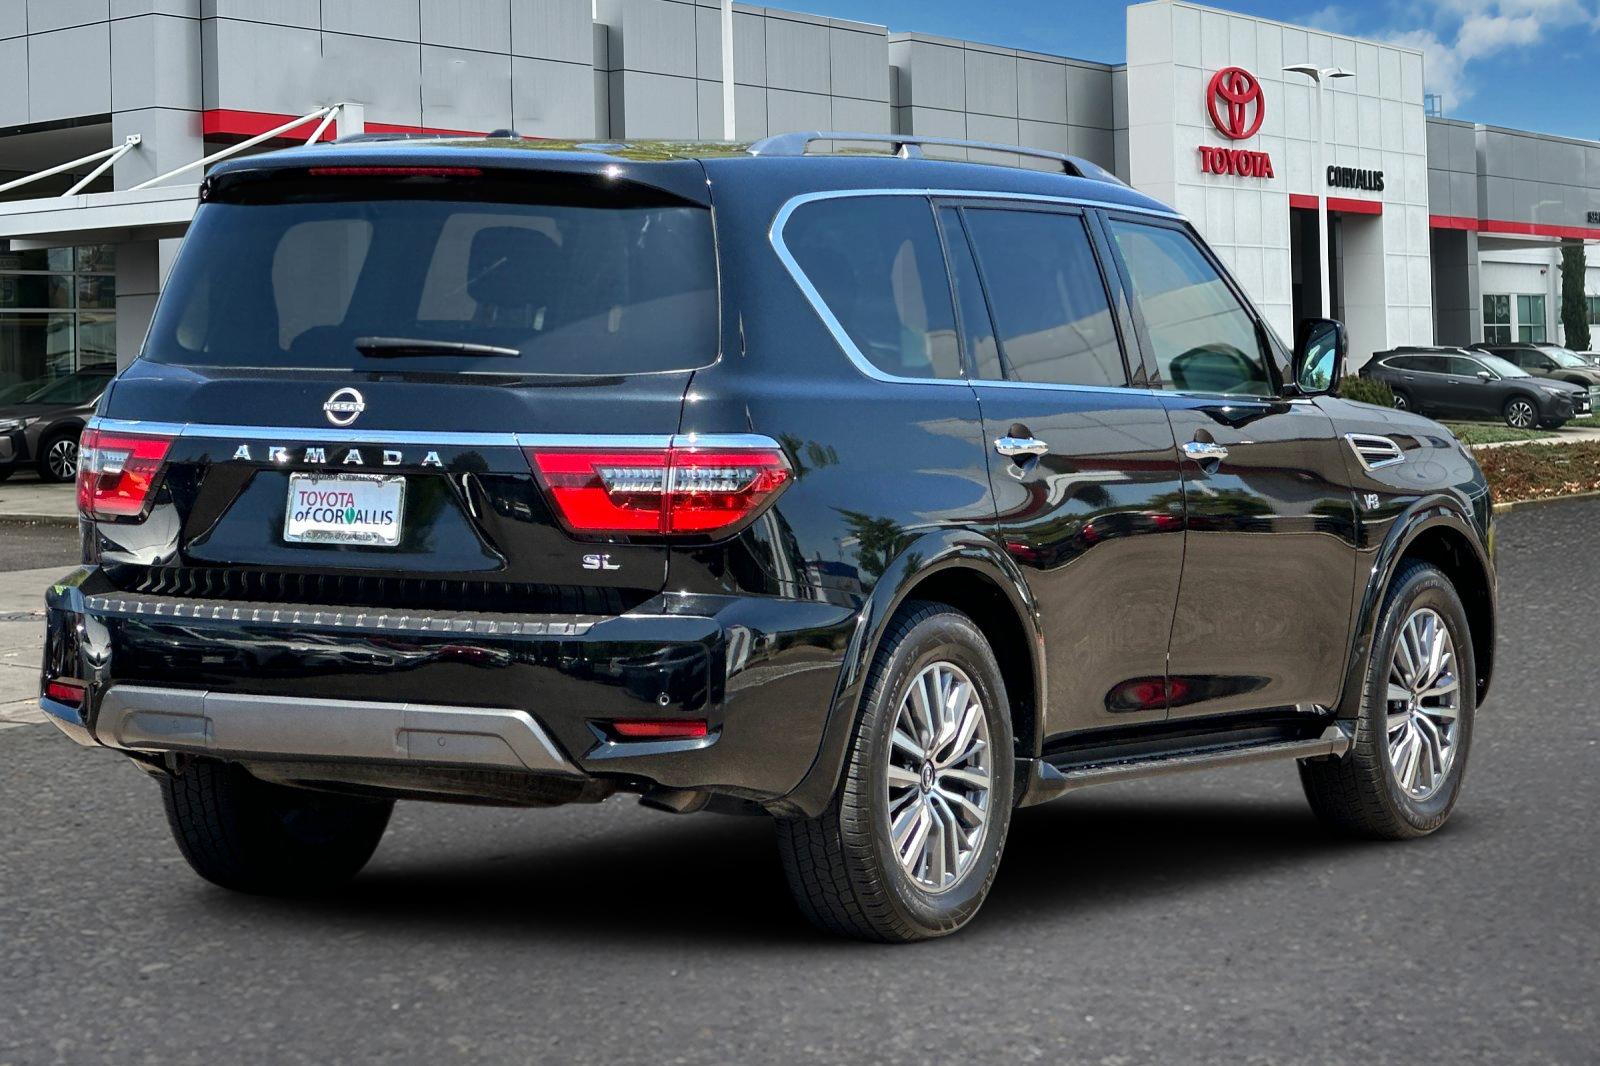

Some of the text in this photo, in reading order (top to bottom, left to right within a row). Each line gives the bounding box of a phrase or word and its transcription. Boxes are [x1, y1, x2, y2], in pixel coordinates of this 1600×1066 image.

[1199, 146, 1274, 178] TOYOTA
[1326, 165, 1385, 191] CORVALLIS
[323, 401, 365, 412] NISSAN
[232, 444, 444, 468] ARMADA
[299, 491, 355, 508] TOYOTA
[295, 507, 313, 523] of
[582, 554, 621, 570] SL
